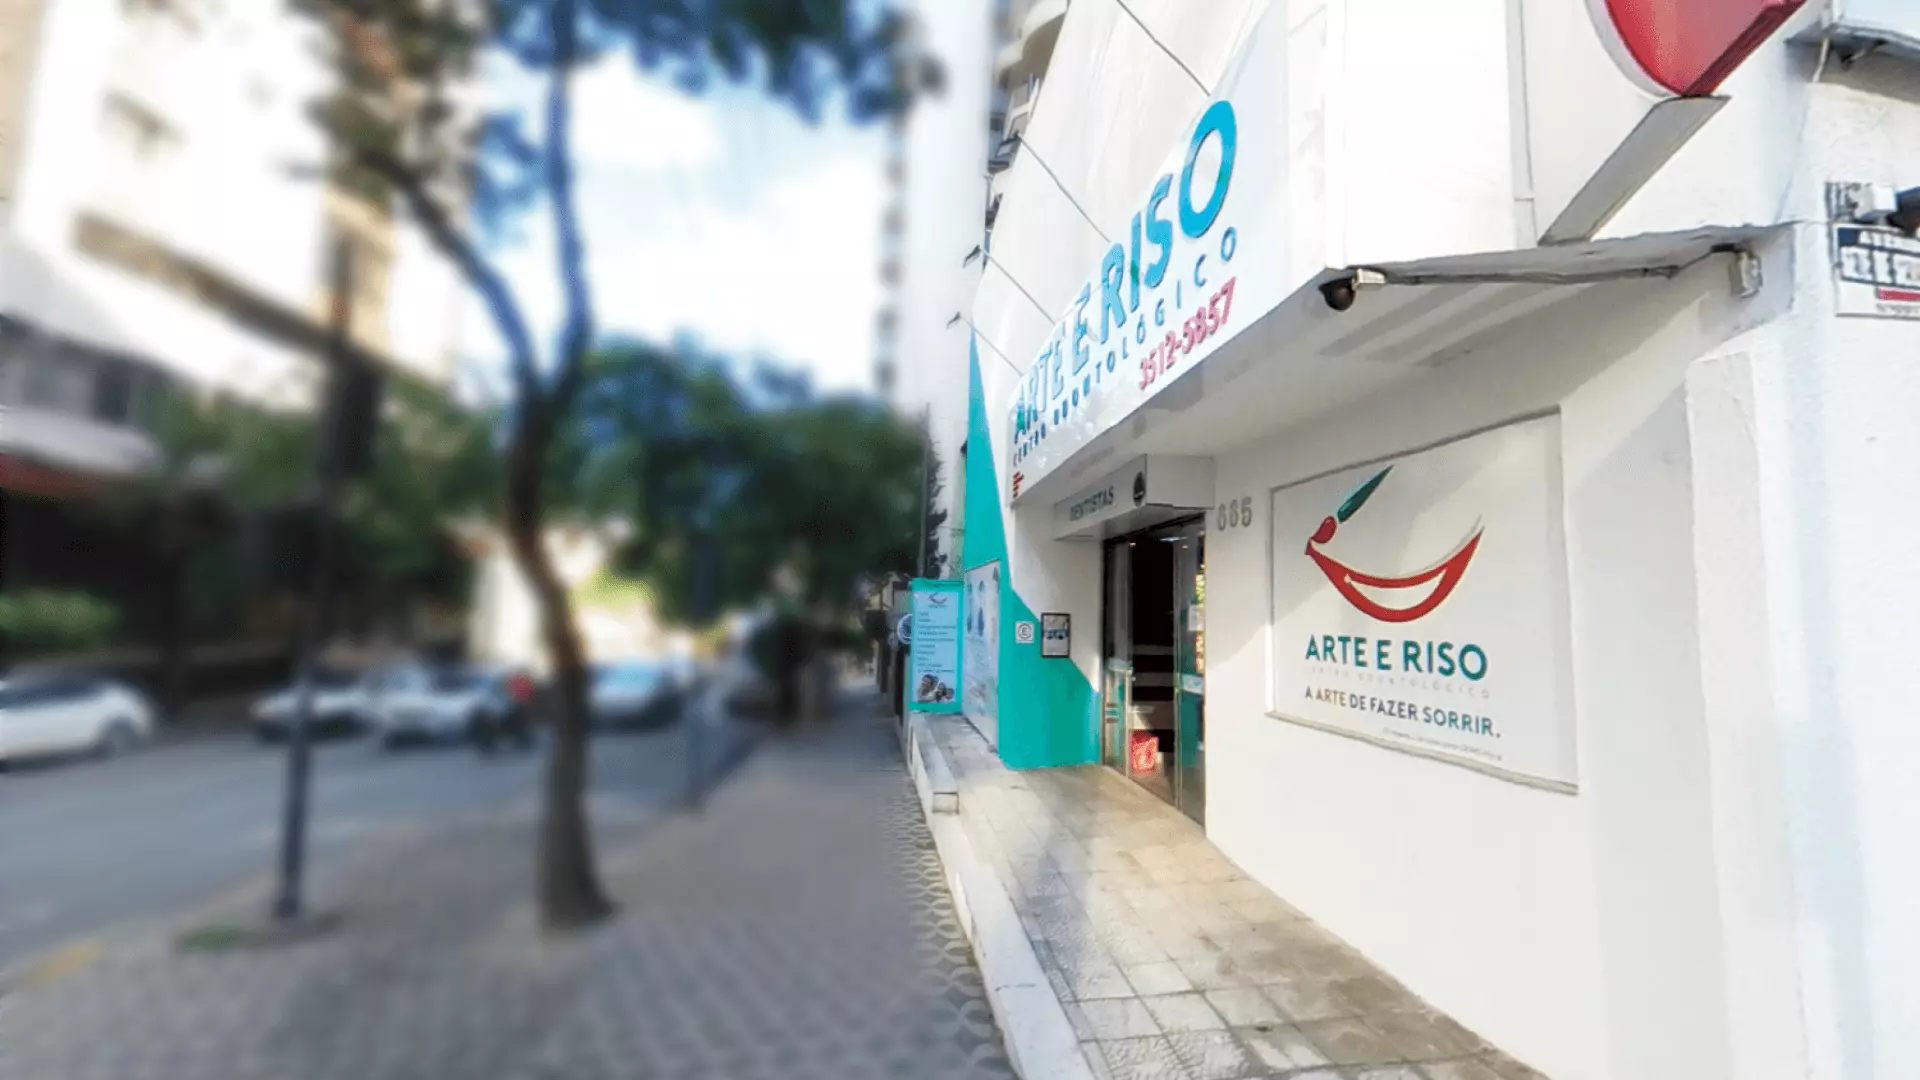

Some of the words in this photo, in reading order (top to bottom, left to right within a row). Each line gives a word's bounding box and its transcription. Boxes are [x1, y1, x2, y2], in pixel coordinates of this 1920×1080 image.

[1014, 320, 1066, 444] ARTE
[1072, 279, 1091, 377] E
[1100, 99, 1238, 345] RISO
[1138, 275, 1238, 391] 3512-5857
[1304, 633, 1369, 669] ARTE
[1376, 639, 1392, 671] E
[1402, 640, 1488, 682] RISO
[1304, 685, 1313, 700] A
[1315, 688, 1347, 707] ARTE
[1350, 693, 1367, 711] DE
[1370, 696, 1419, 722] FAZER
[1422, 705, 1502, 739] SORRIR.
